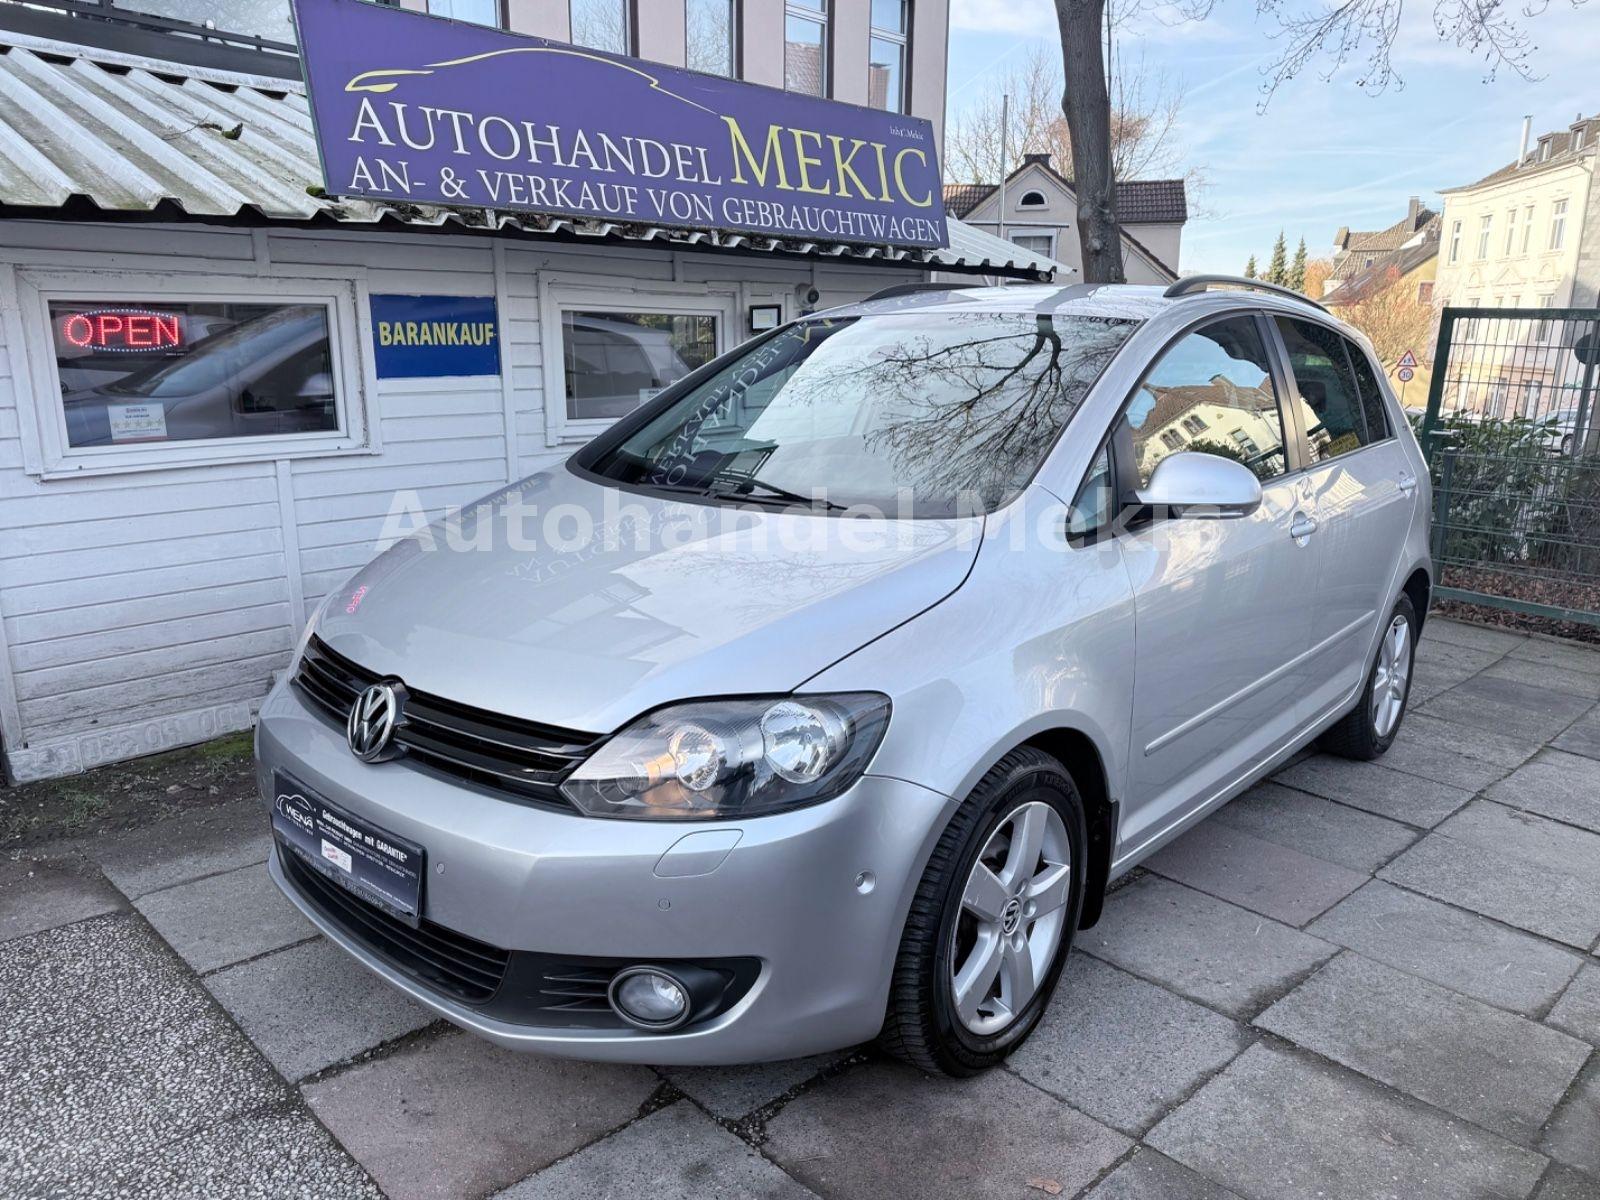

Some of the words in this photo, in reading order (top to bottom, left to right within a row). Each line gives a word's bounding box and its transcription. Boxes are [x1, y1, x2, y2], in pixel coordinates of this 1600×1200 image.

[348, 97, 721, 185] AUTOHANDEL
[720, 115, 932, 207] MEKIC
[348, 156, 426, 194] AN-
[440, 167, 470, 199] &
[476, 169, 638, 214] VERKAUF
[646, 188, 713, 222] VON
[722, 197, 941, 243] GEBRAUCHTWAGEN
[65, 313, 179, 346] OPEN
[379, 321, 494, 346] BARANKAUF
[364, 834, 374, 847] mit
